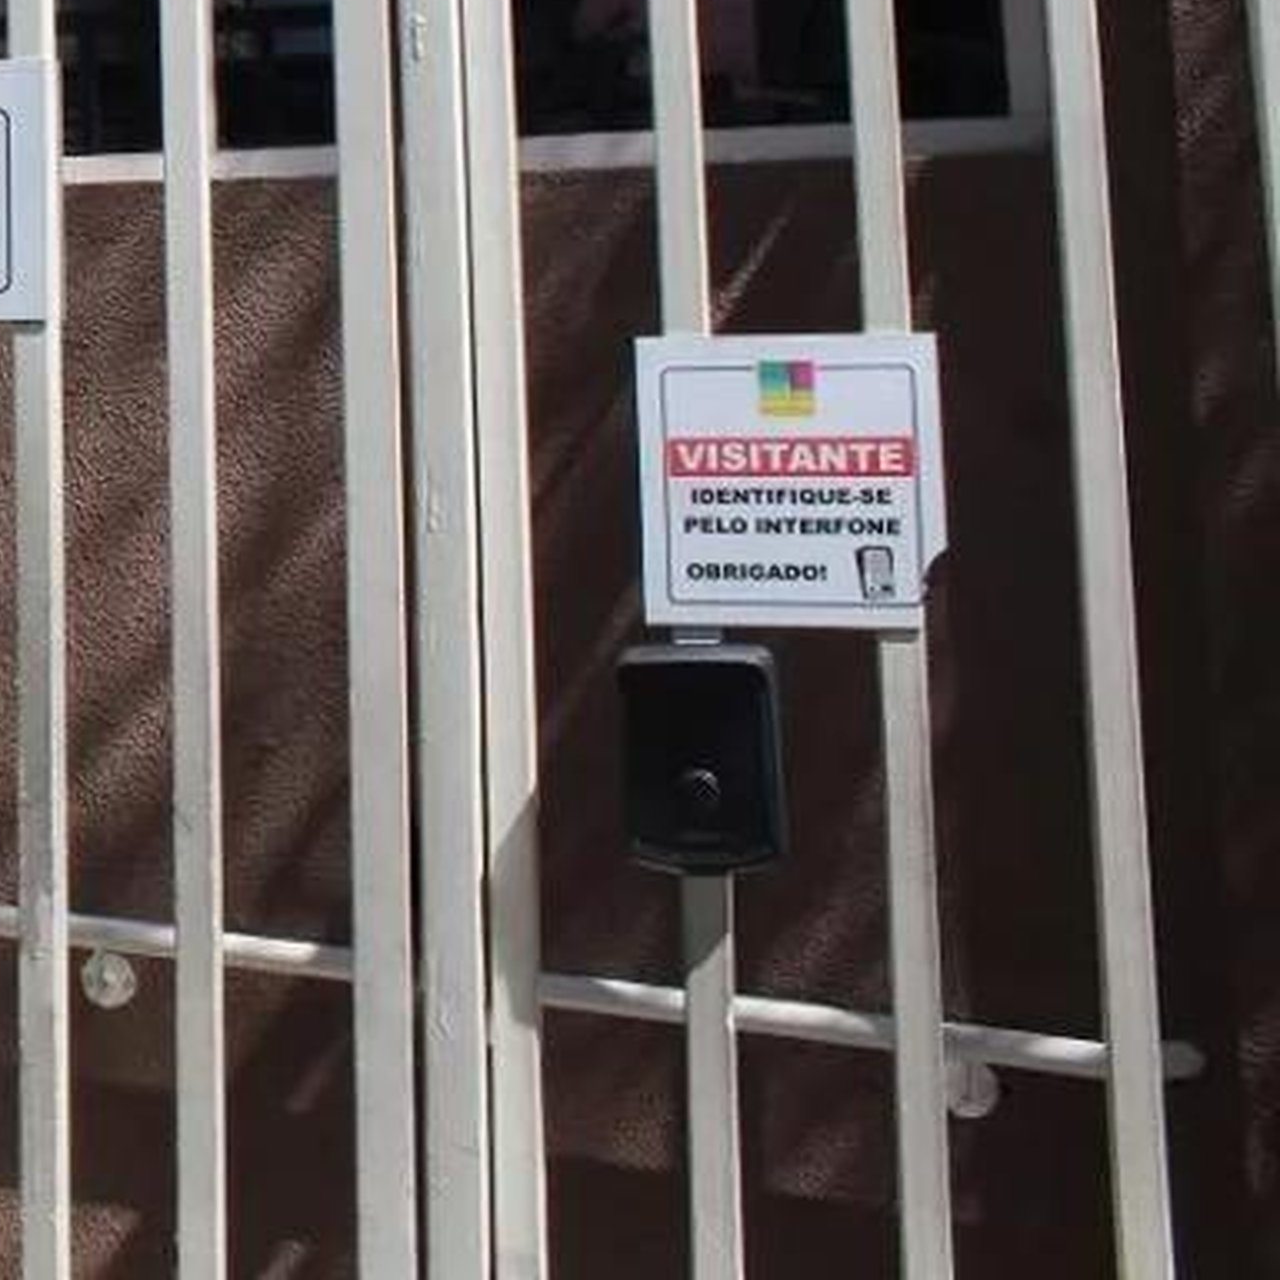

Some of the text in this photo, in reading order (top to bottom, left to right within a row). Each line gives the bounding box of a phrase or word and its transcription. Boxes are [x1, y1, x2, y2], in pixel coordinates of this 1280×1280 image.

[675, 441, 905, 473] VISITANTE
[690, 486, 892, 506] IDENTIFIQUE-SE
[683, 516, 901, 536] PELO INTERFONE
[685, 562, 828, 582] OBRIGADO!
